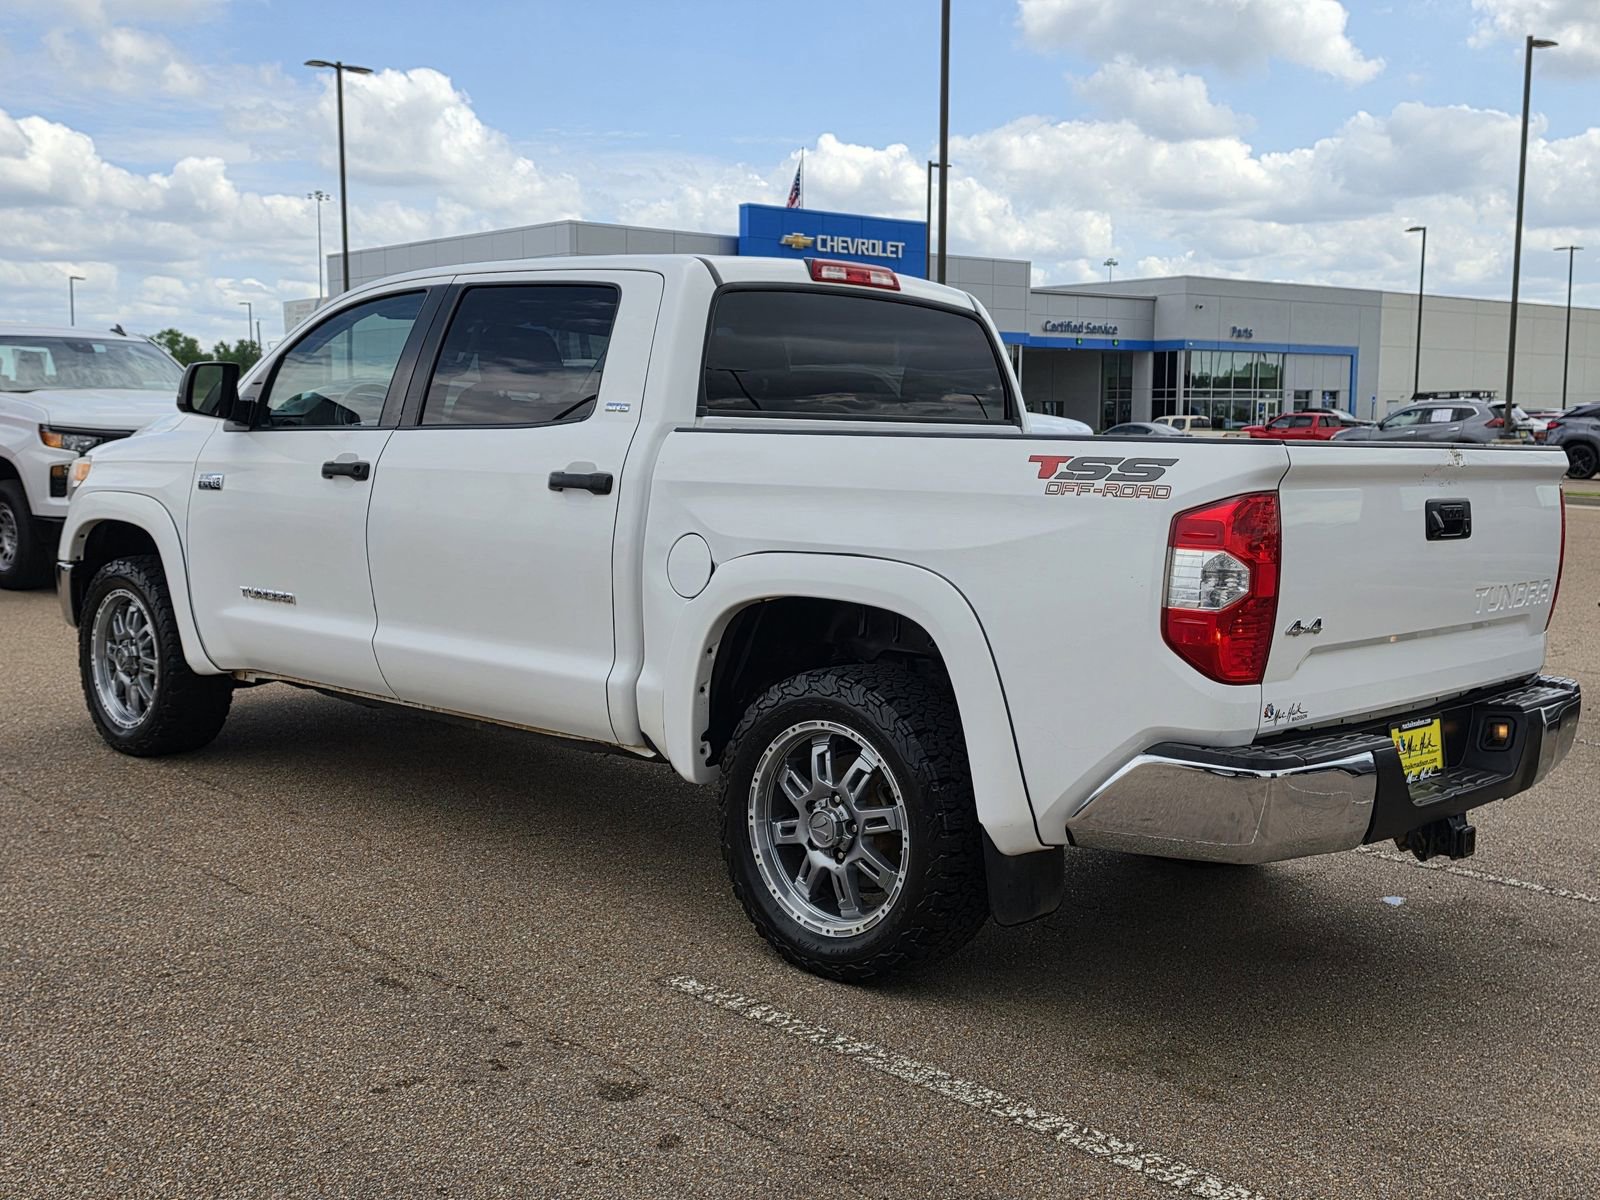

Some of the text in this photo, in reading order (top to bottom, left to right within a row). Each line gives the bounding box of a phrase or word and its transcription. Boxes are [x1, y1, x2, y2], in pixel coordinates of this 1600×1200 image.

[816, 235, 906, 258] CHEVROLET
[1043, 320, 1118, 335] Certified Service
[1231, 326, 1253, 338] Parts
[1045, 481, 1172, 500] OFF-ROAD
[240, 586, 296, 605] TUNDRA
[1475, 579, 1551, 614] TUNDRA
